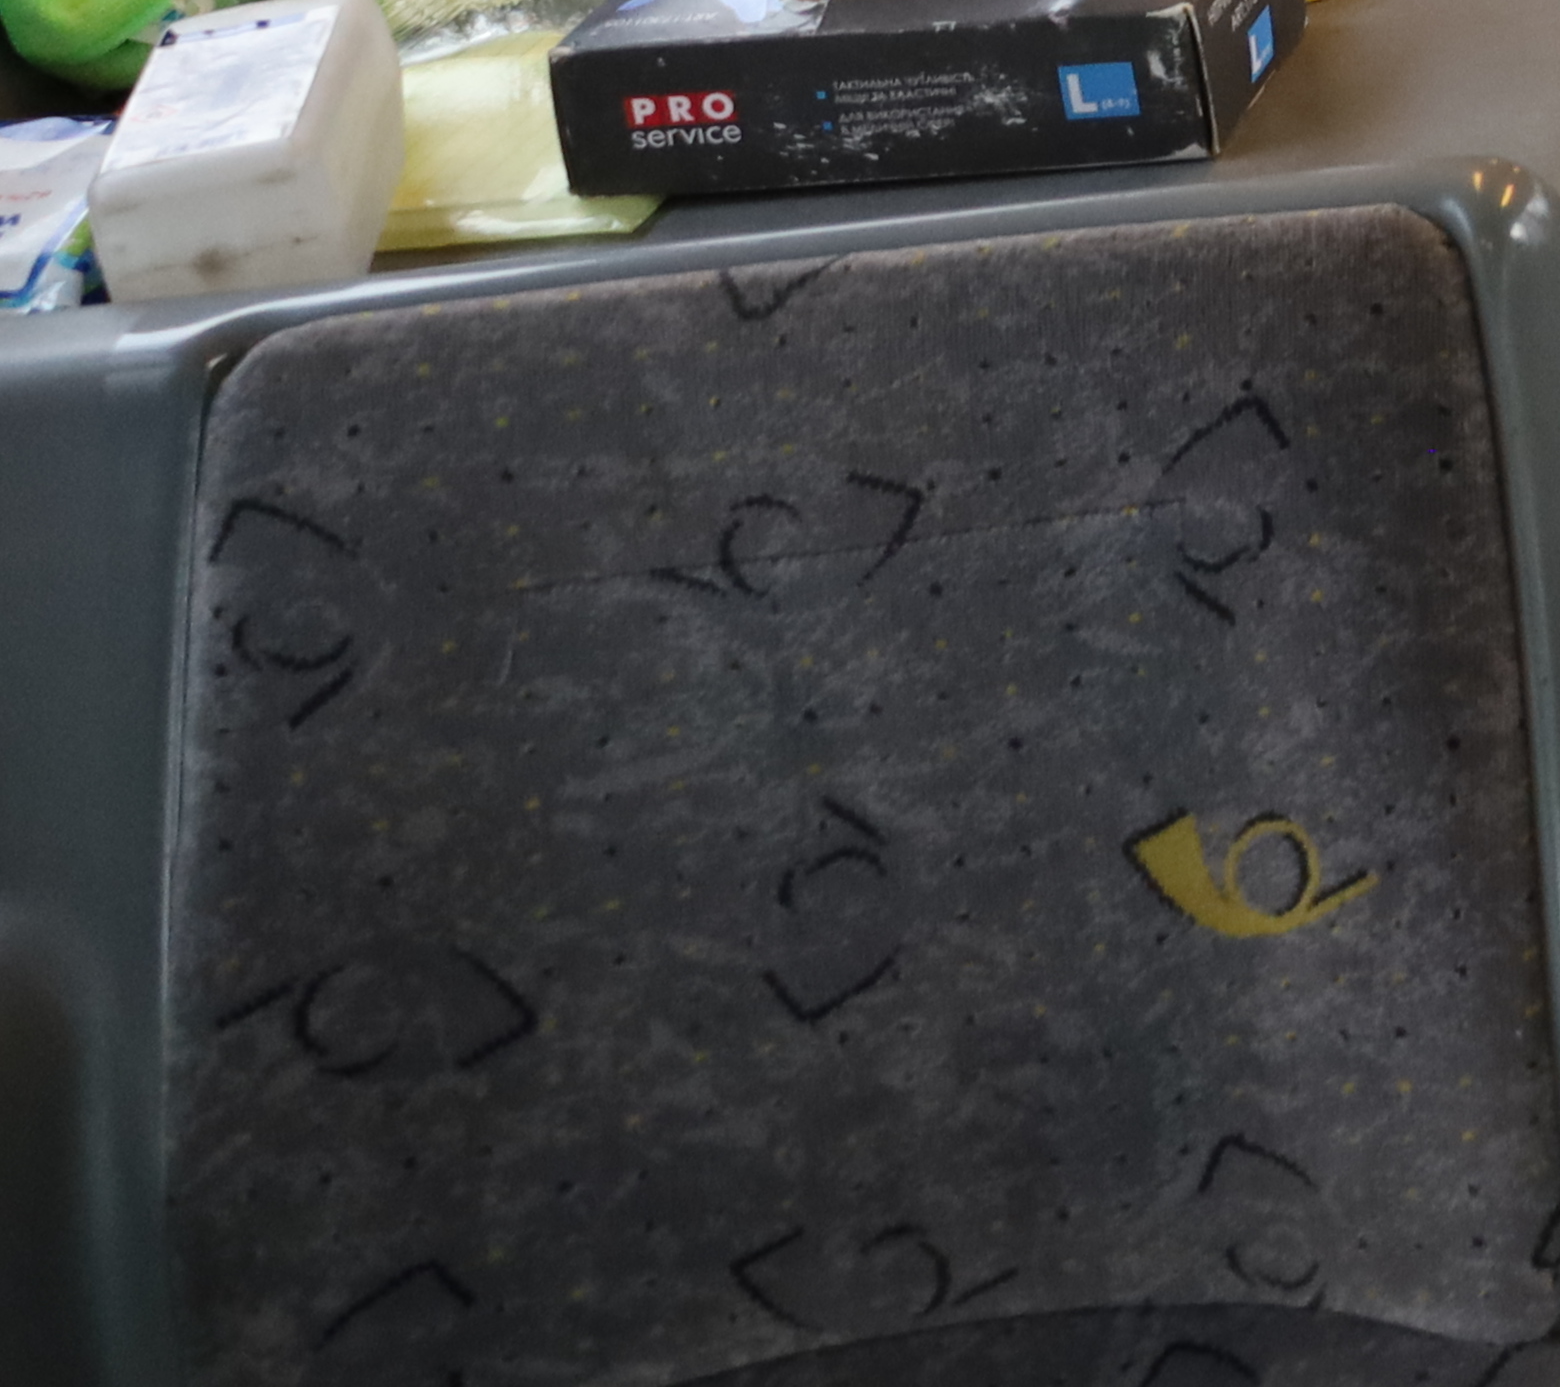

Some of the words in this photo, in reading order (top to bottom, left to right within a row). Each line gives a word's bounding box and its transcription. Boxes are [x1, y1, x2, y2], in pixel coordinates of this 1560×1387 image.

[631, 92, 734, 125] PRO
[1066, 73, 1098, 114] L
[631, 124, 742, 149] service
